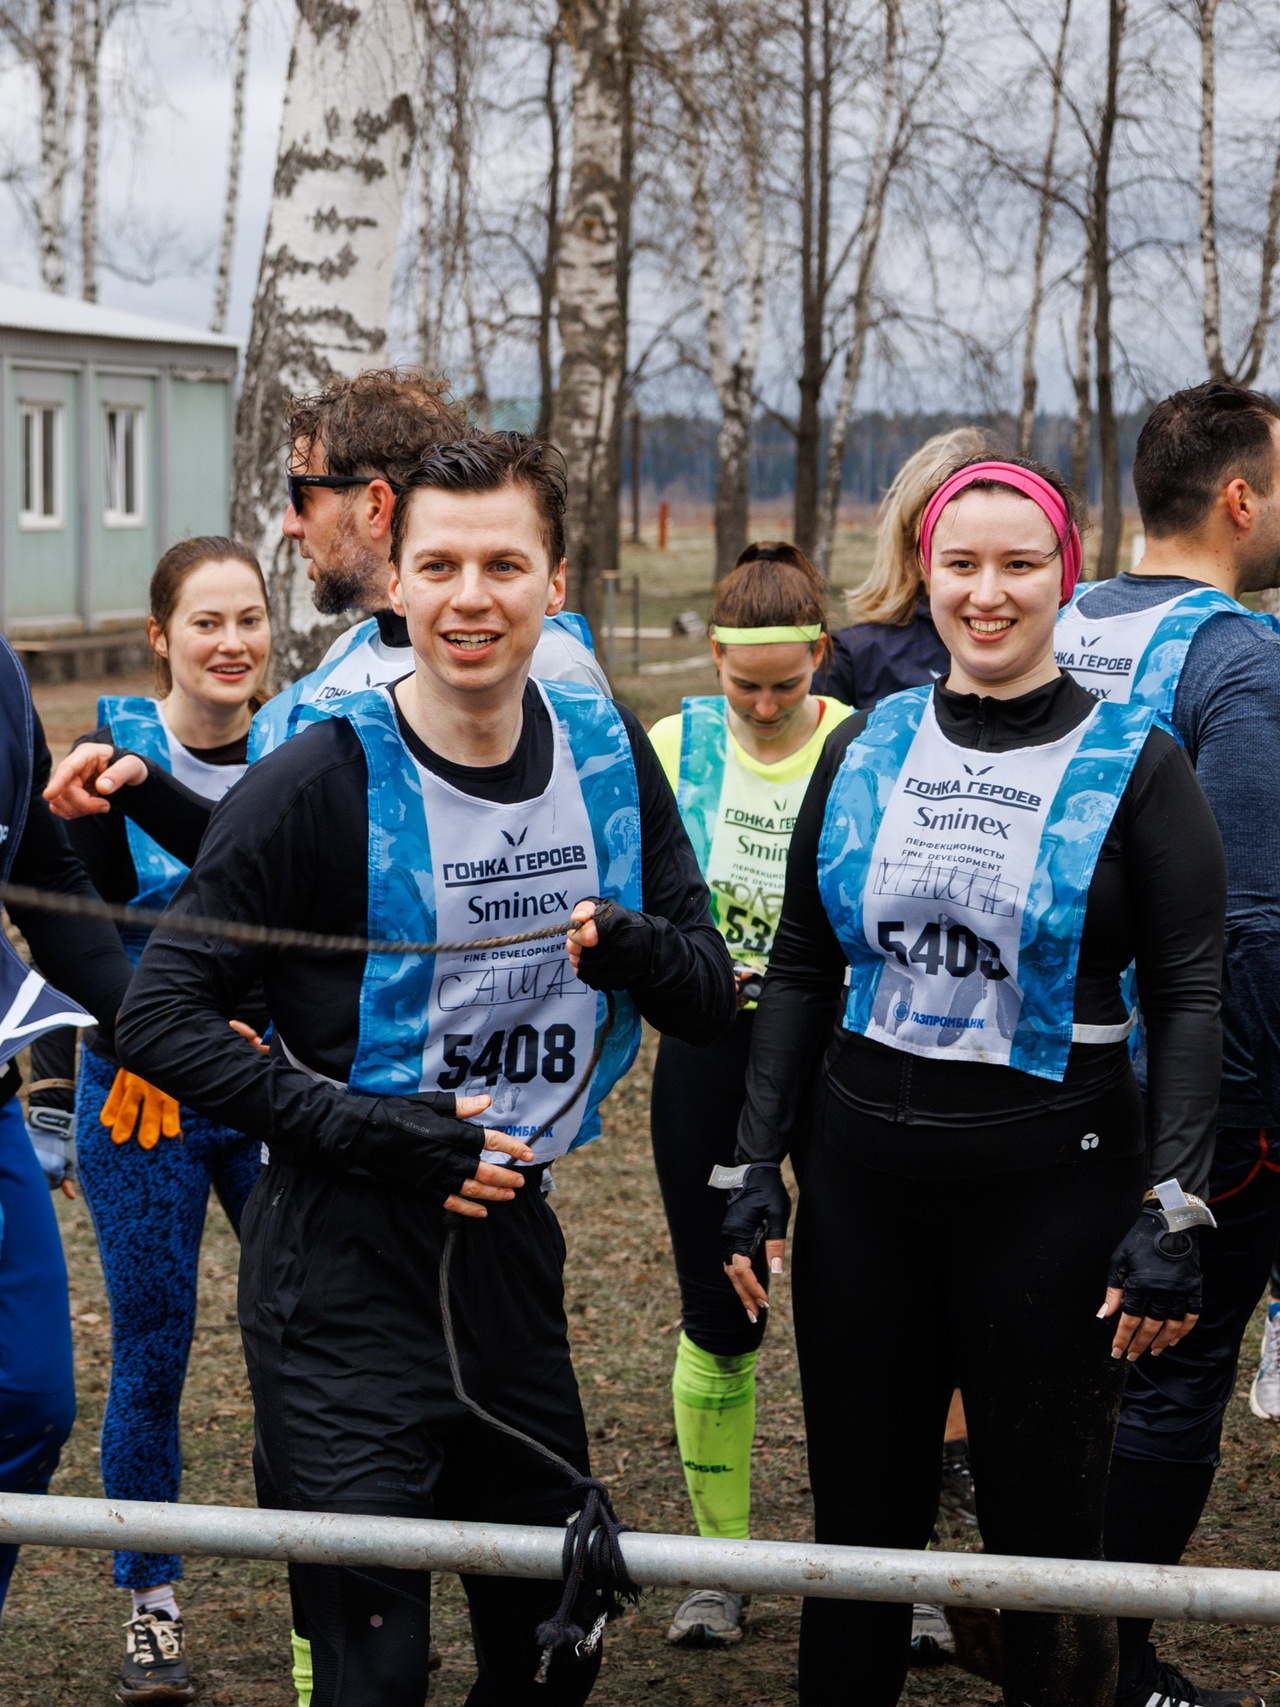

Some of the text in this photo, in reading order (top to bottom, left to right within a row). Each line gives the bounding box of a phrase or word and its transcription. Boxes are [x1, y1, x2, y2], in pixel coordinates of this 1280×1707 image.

[1079, 653, 1133, 671] ГЕРОЕВ
[905, 777, 1042, 807] ГОНКА ГЕРОЕВ
[725, 808, 775, 830] ГОНКА
[913, 806, 1012, 840] Sminex
[901, 849, 1002, 872] FINE DEVELOPMENT
[905, 837, 1006, 860] ПЕРФЕКЦИОНИСТЫ
[443, 845, 587, 881] ГОНКА ГЕРОЕВ
[468, 890, 569, 925] Sminex
[463, 942, 567, 963] FINE DEVELOPMENT
[437, 958, 578, 1012] САША
[910, 1011, 985, 1030] ГАЗПРОМБАНК
[436, 1023, 577, 1090] 5408
